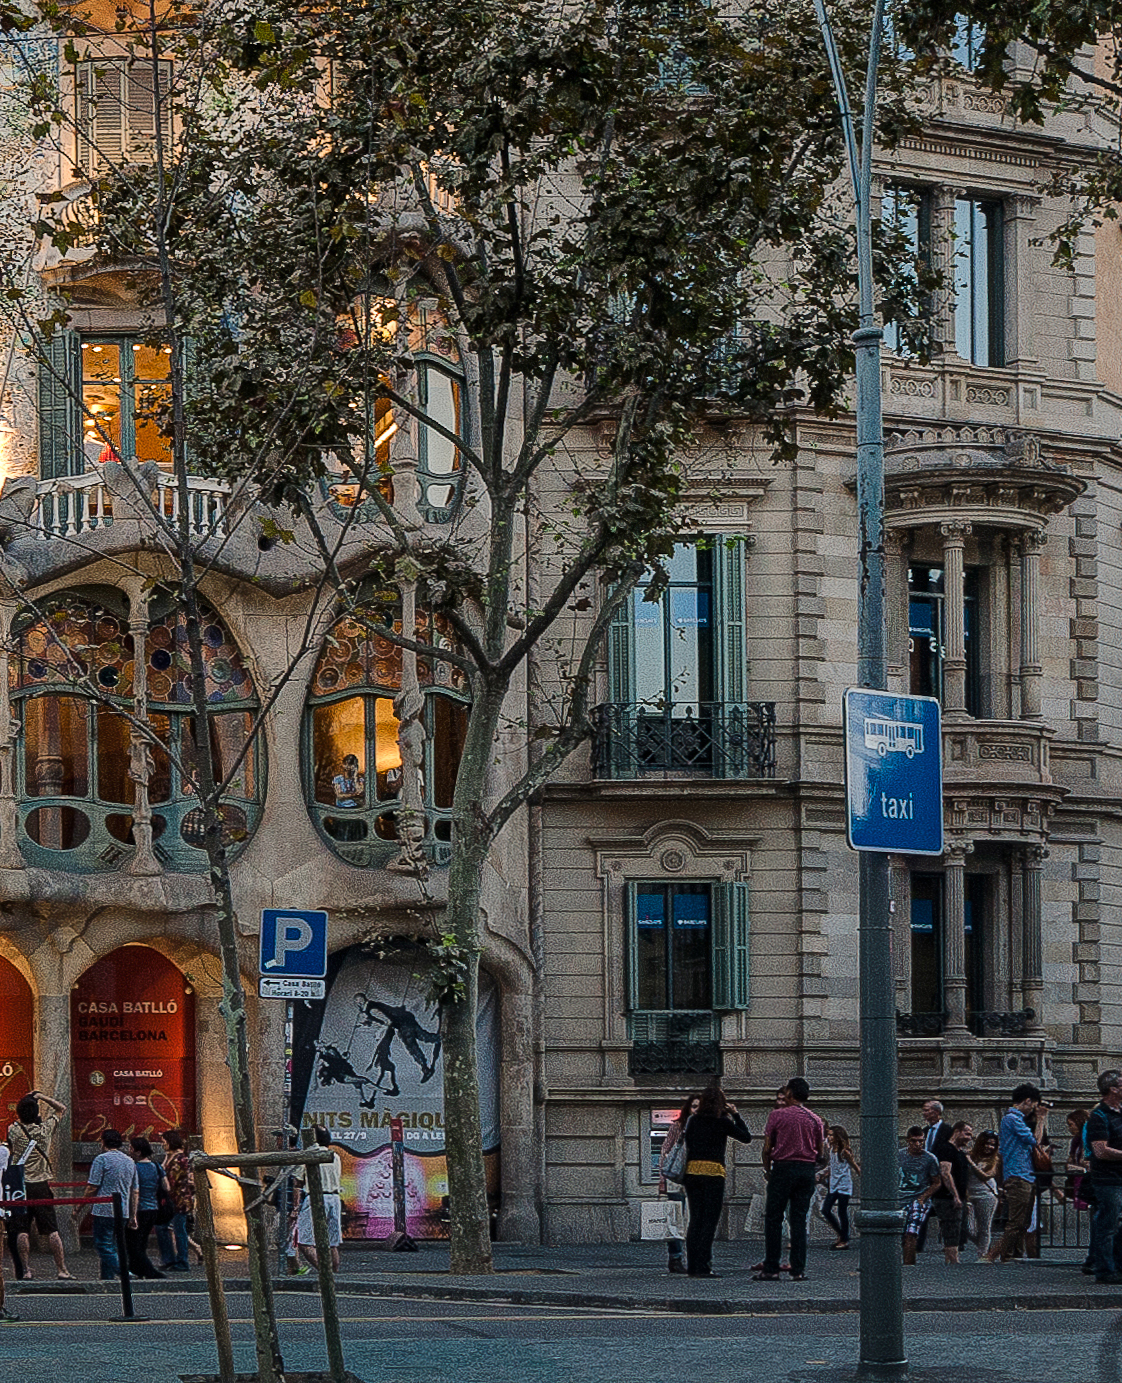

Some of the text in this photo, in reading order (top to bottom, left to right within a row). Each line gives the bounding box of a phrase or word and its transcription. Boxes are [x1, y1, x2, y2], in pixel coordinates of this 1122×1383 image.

[880, 791, 914, 820] taxi
[274, 917, 313, 967] P
[78, 999, 178, 1014] CASA BATLLÓ
[78, 1030, 167, 1041] BARCELONA
[302, 1111, 353, 1128] NITS
